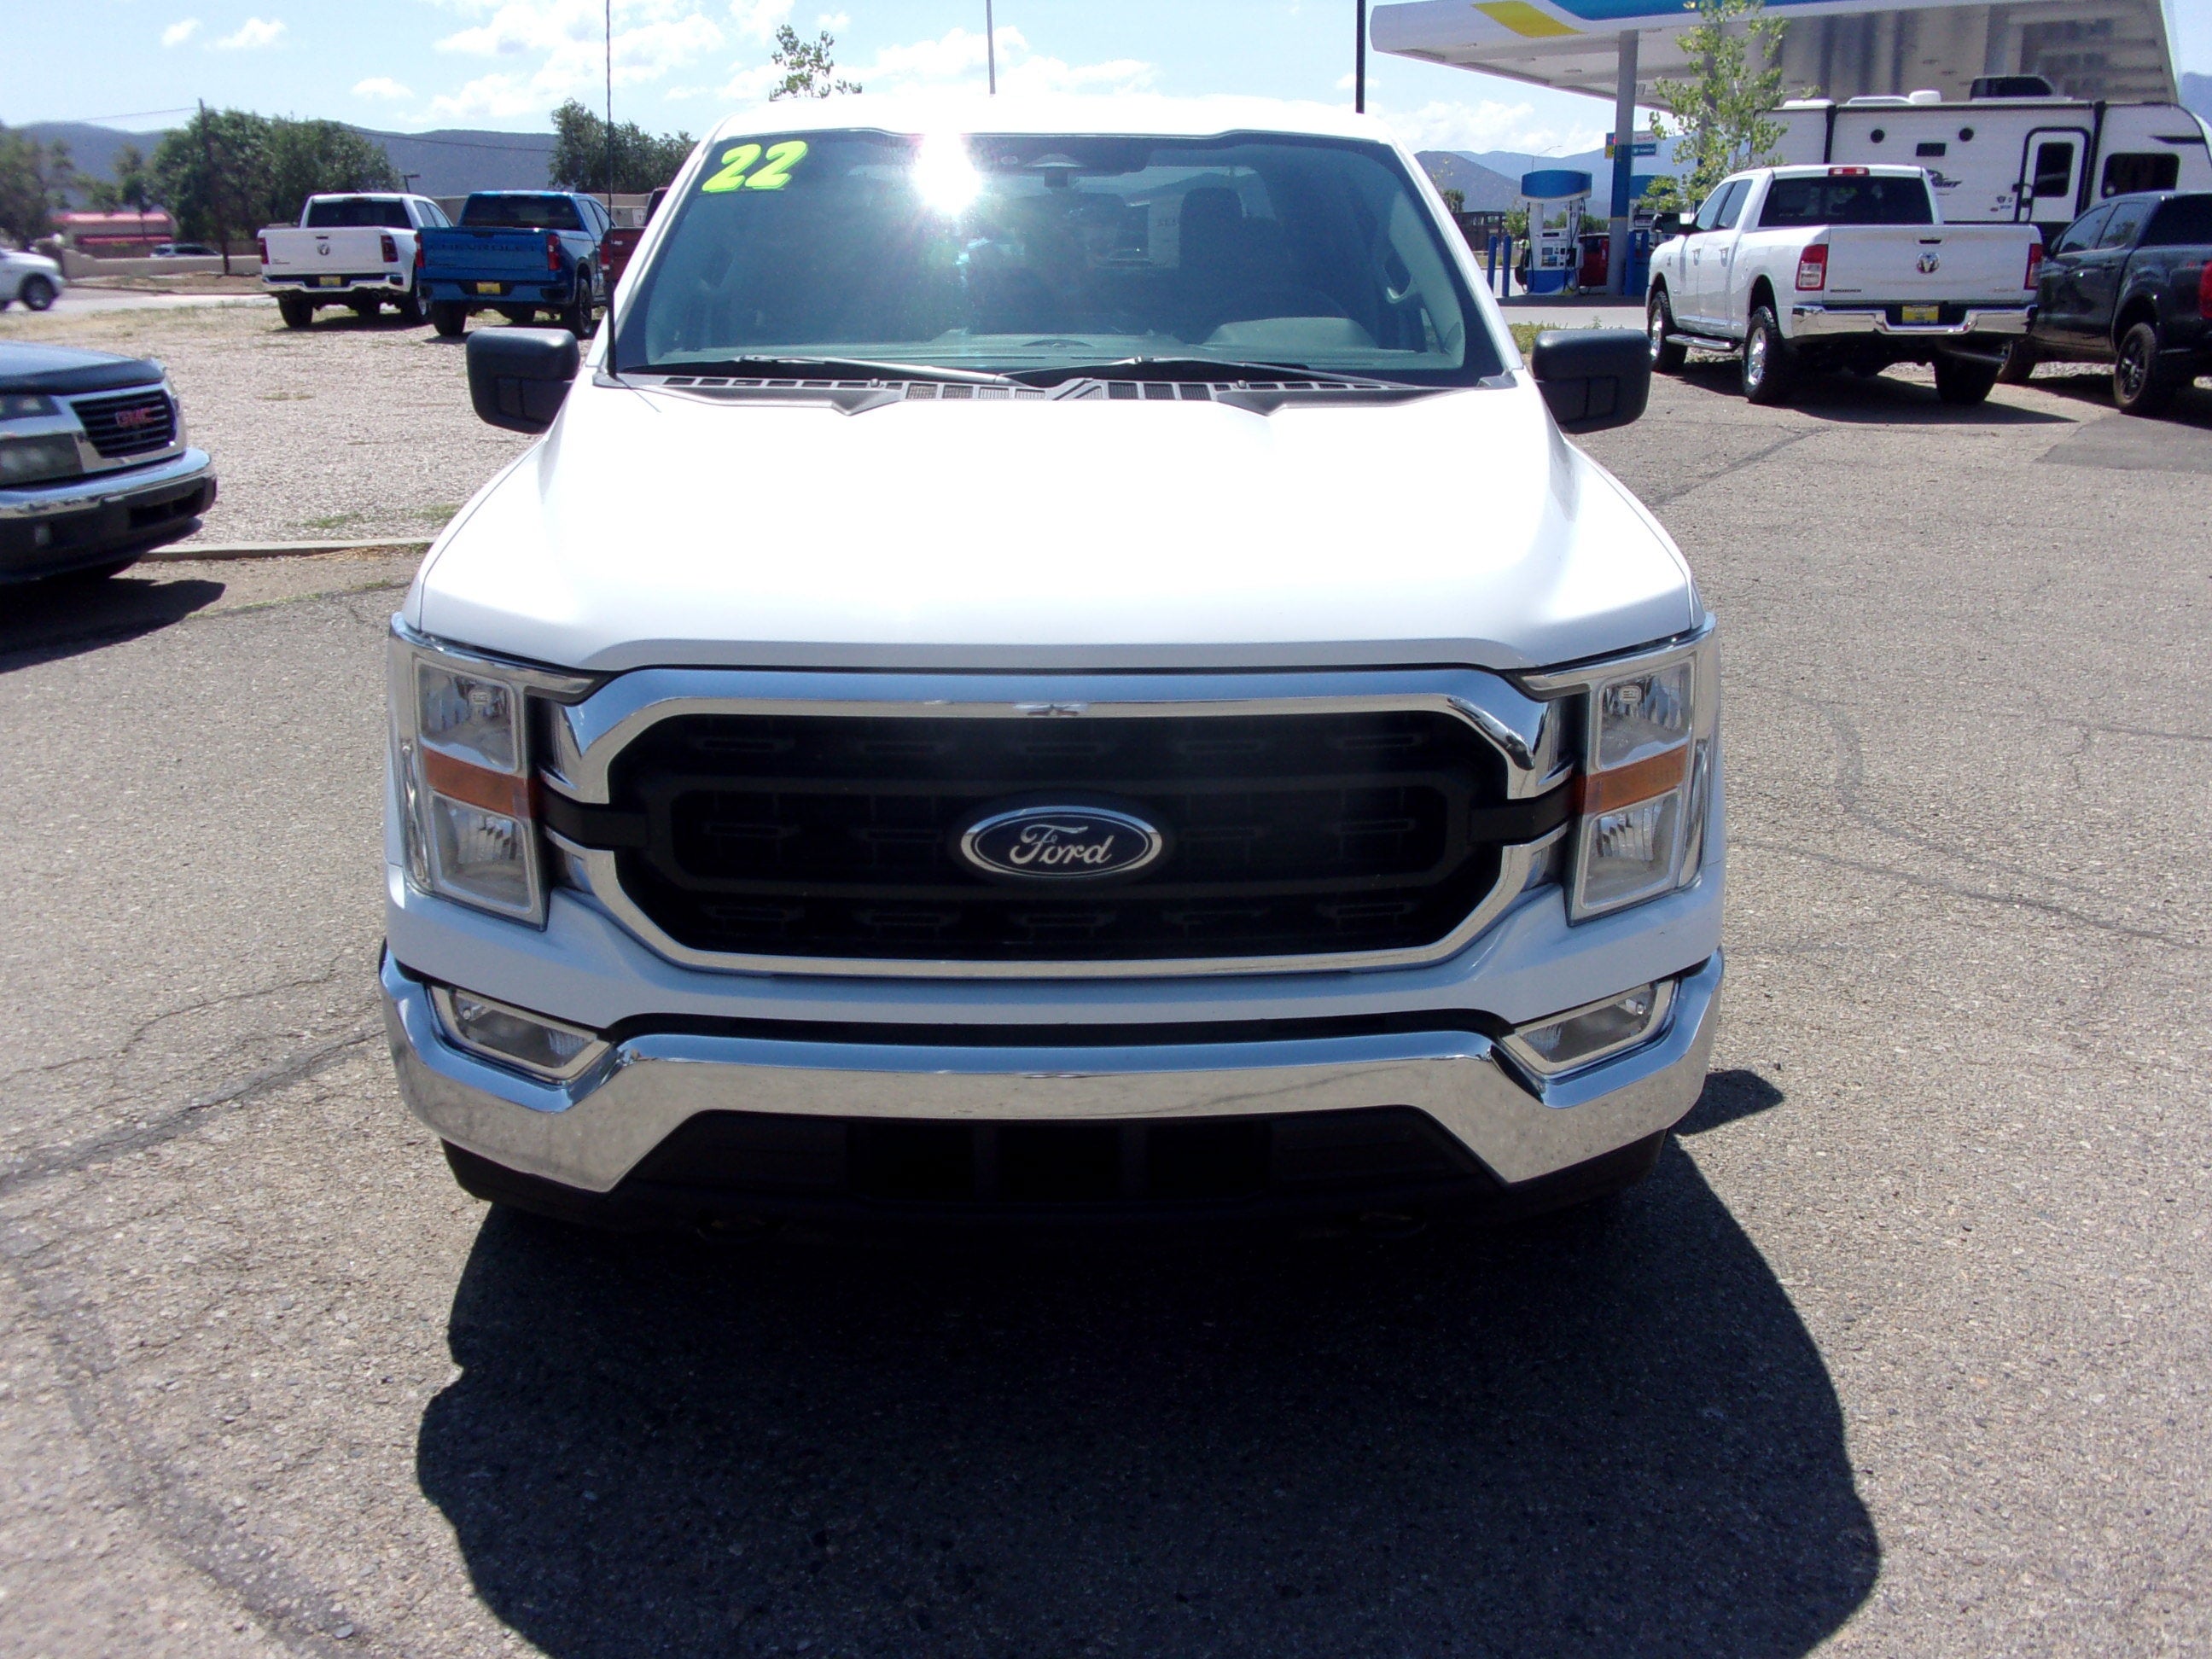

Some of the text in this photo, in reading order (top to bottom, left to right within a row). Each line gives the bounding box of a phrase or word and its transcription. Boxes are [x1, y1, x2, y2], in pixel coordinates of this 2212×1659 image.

[702, 141, 808, 193] 22
[429, 242, 537, 253] CHEVROLET
[116, 407, 154, 426] GMC
[1010, 824, 1115, 865] Ford
